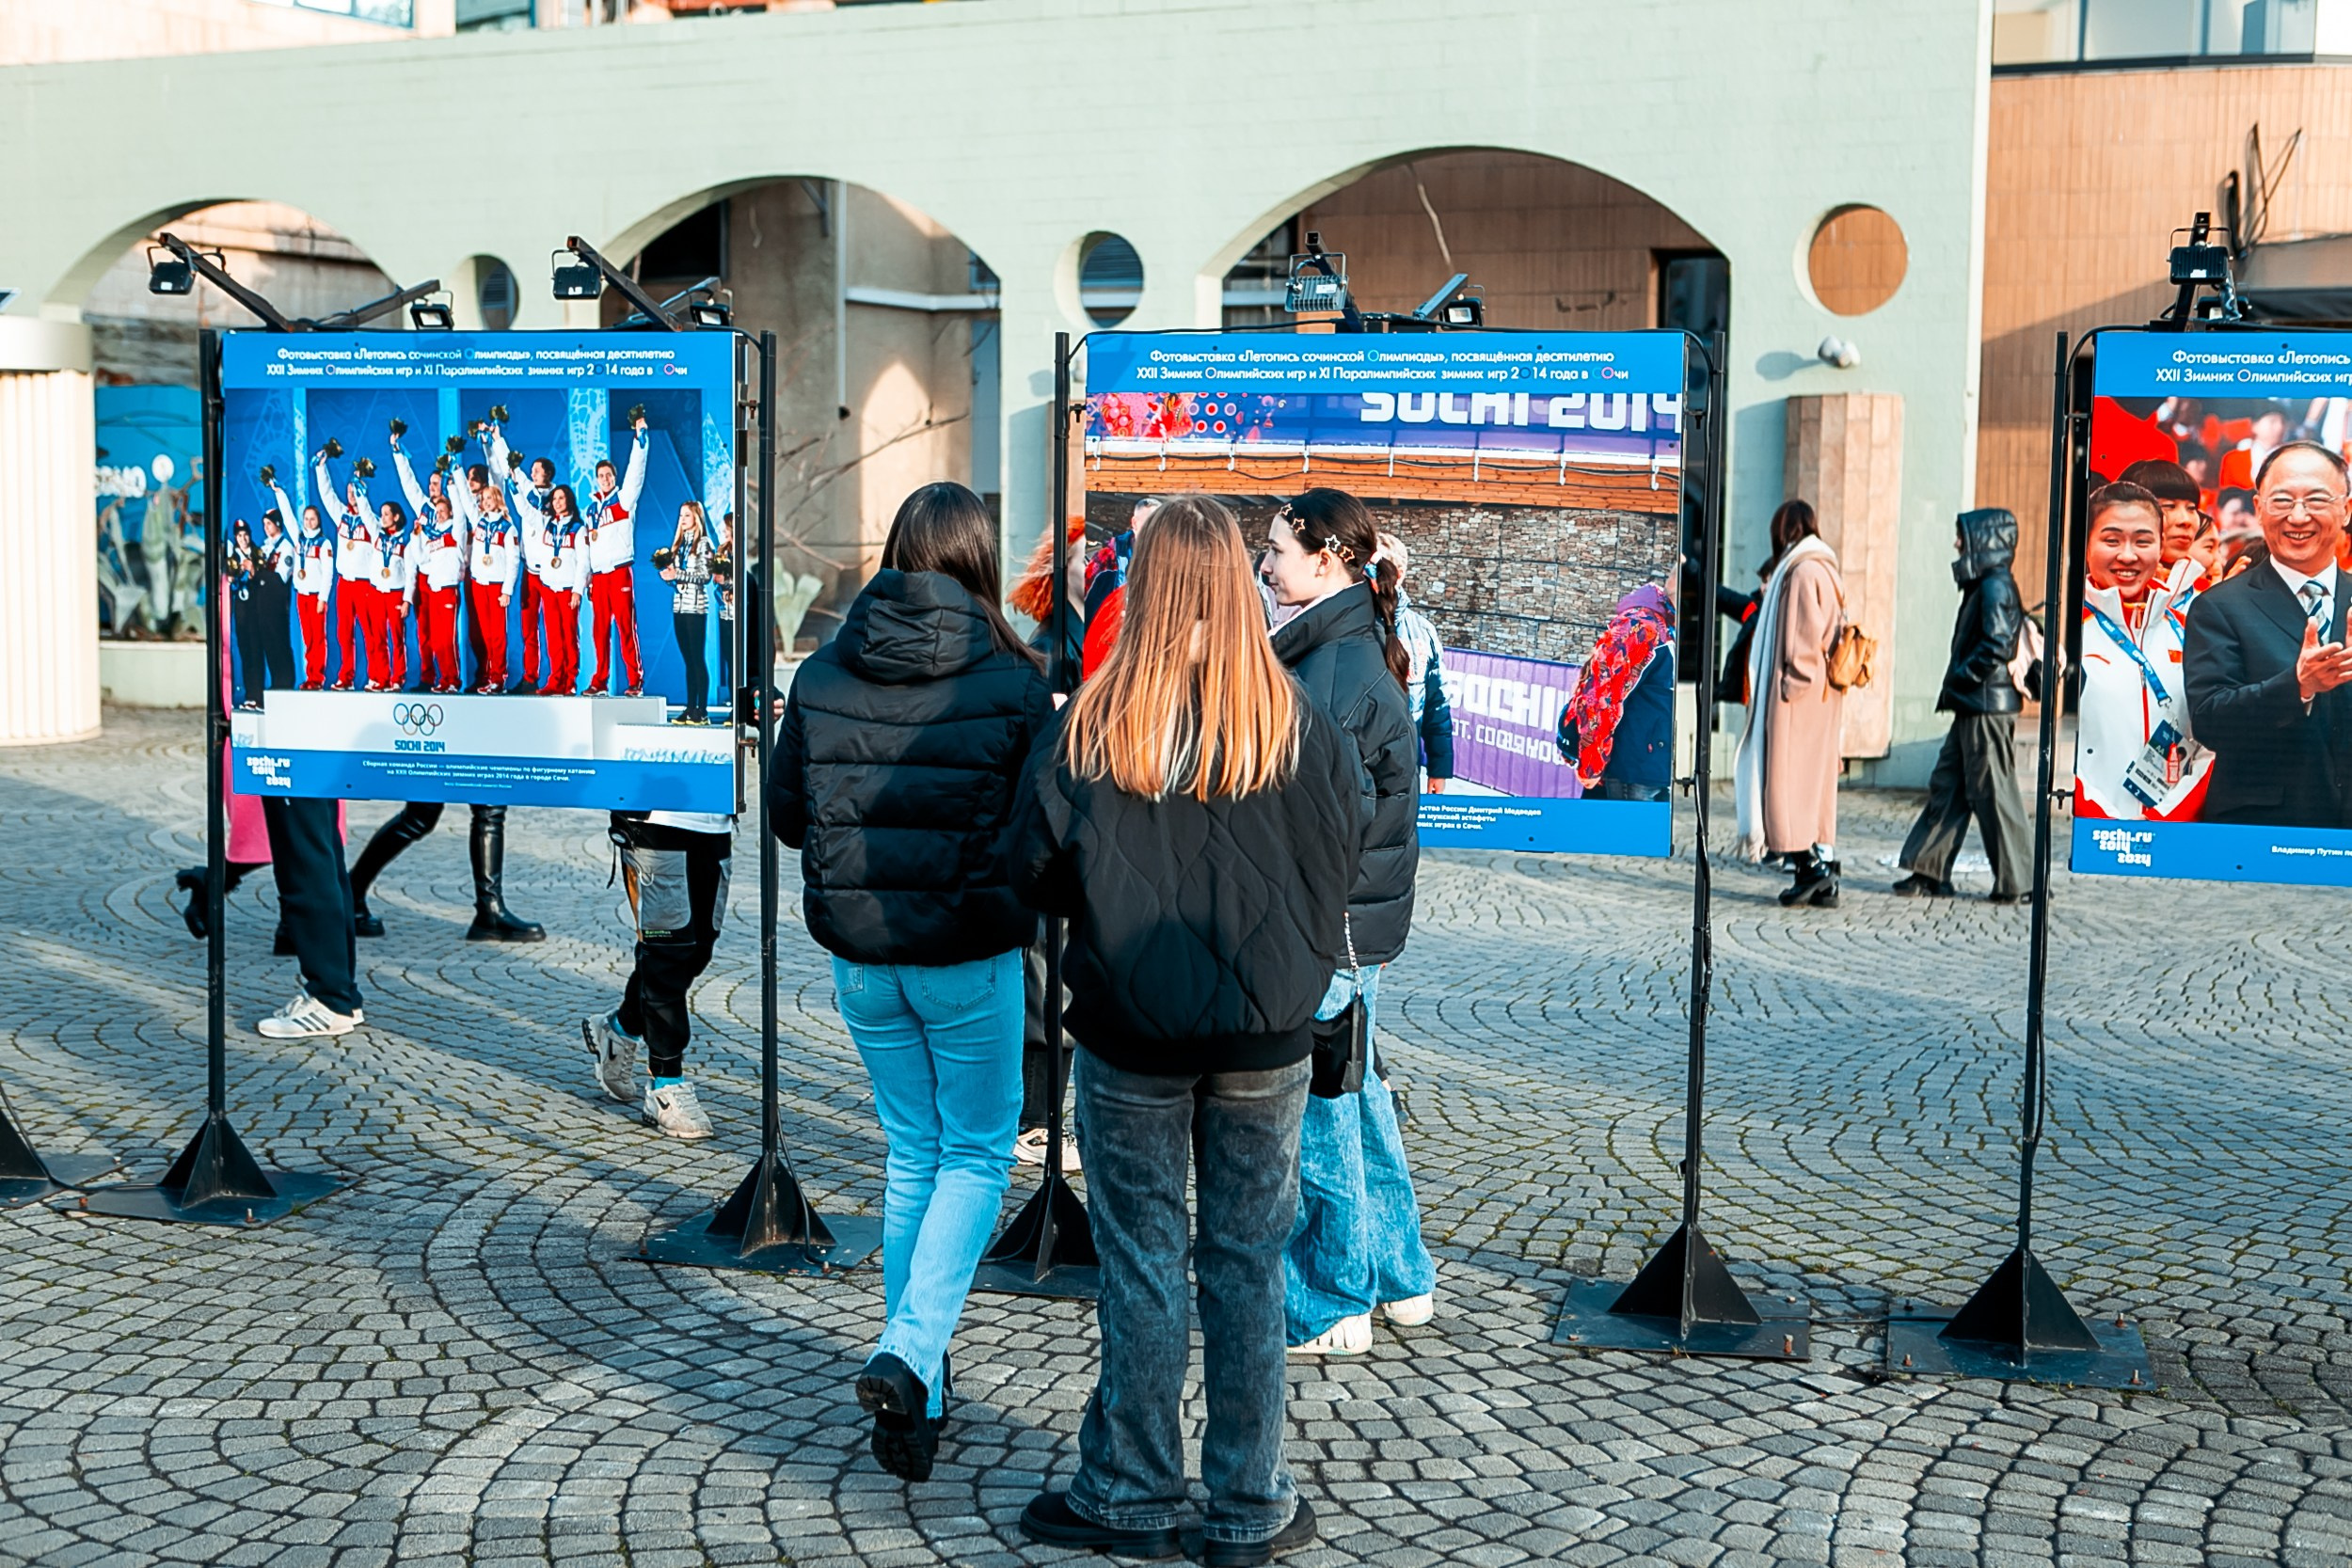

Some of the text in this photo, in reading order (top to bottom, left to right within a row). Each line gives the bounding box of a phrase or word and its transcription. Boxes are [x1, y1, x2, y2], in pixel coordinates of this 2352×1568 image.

[278, 347, 675, 361] Фотовыставка «Летопись сочинской Олимпиады», посвящённая десятилетию
[1150, 350, 1615, 364] Фотовыставка «Летопись сочинской Олимпиады», посвящённая десятилетию
[2172, 349, 2351, 365] Фотовыставка «Летопись
[267, 364, 285, 375] XXII
[287, 364, 324, 375] Зимних
[325, 364, 393, 376] Олимпийских
[395, 366, 413, 378] игр
[423, 364, 434, 375] XI
[436, 364, 523, 378] Паралимпийских
[528, 367, 564, 376] зимних
[566, 367, 585, 378] игр
[620, 367, 645, 377] года
[646, 367, 654, 376] в
[1136, 366, 1158, 379] XXII
[1160, 366, 1203, 379] Зимних
[1204, 366, 1285, 380] Олимпийских
[1286, 370, 1308, 382] игр
[1309, 370, 1317, 379] и
[1318, 366, 1330, 379] XI
[1332, 366, 1437, 382] Паралимпийских
[1440, 370, 1485, 380] зимних
[1487, 370, 1509, 383] игр
[1549, 370, 1579, 381] года
[1581, 370, 1589, 380] в
[2155, 368, 2181, 382] XXII
[2183, 368, 2234, 383] Зимних
[2236, 368, 2332, 384] Олимпийских
[394, 739, 446, 752] SOCHI 2014
[246, 755, 291, 768] sochi.ru
[362, 760, 388, 769] Сборная
[1468, 806, 1503, 816] Дмитрий
[1504, 807, 1542, 816] Медведев
[2091, 828, 2153, 843] sochi.ru
[2271, 845, 2316, 857] Владимир
[2316, 847, 2344, 857] Путин
